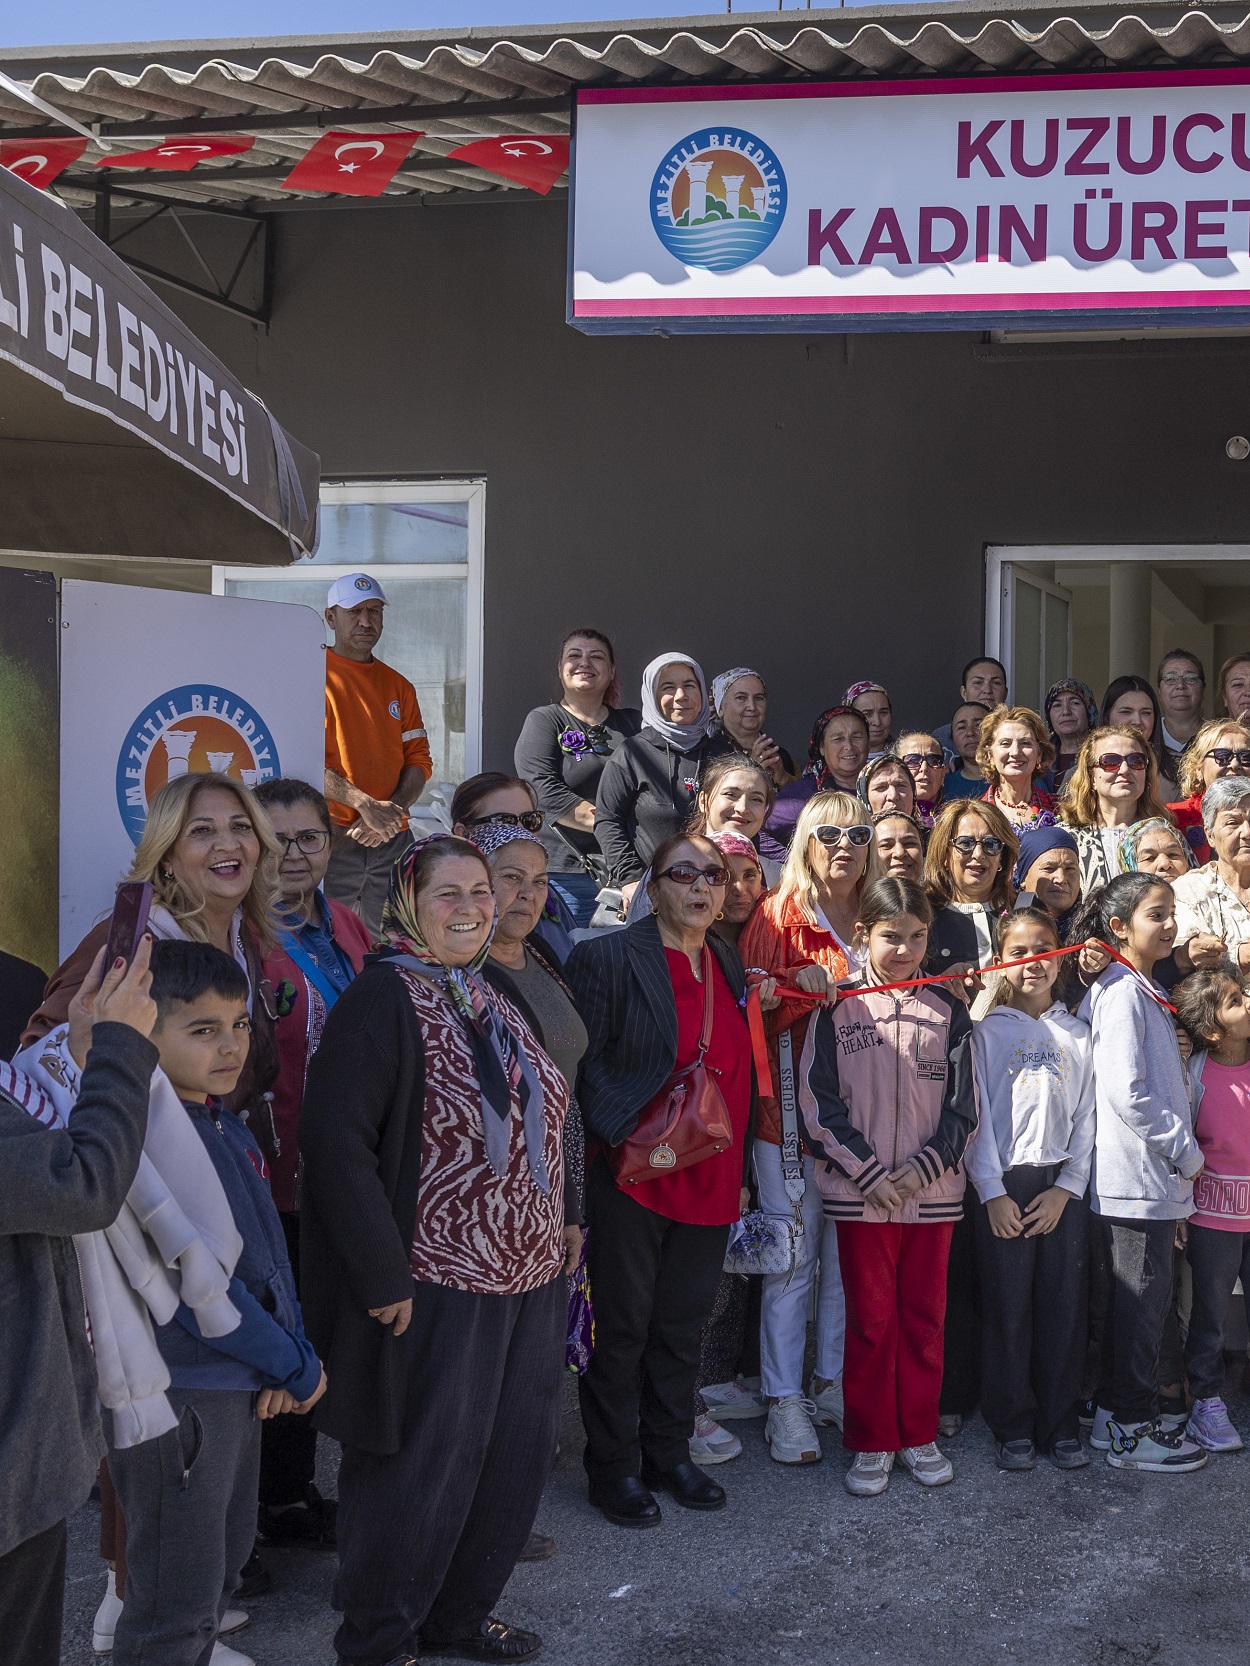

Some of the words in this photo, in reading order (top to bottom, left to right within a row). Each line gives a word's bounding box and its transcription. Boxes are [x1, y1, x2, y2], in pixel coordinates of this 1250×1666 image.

[807, 203, 1048, 266] KADIN
[41, 243, 249, 485] BELEDİYESİ
[191, 694, 274, 782] BELEDİYE
[842, 1032, 876, 1055] HEART
[1021, 1051, 1062, 1063] DREAMS
[917, 1063, 933, 1071] SINCE
[782, 1068, 795, 1112] GUESS
